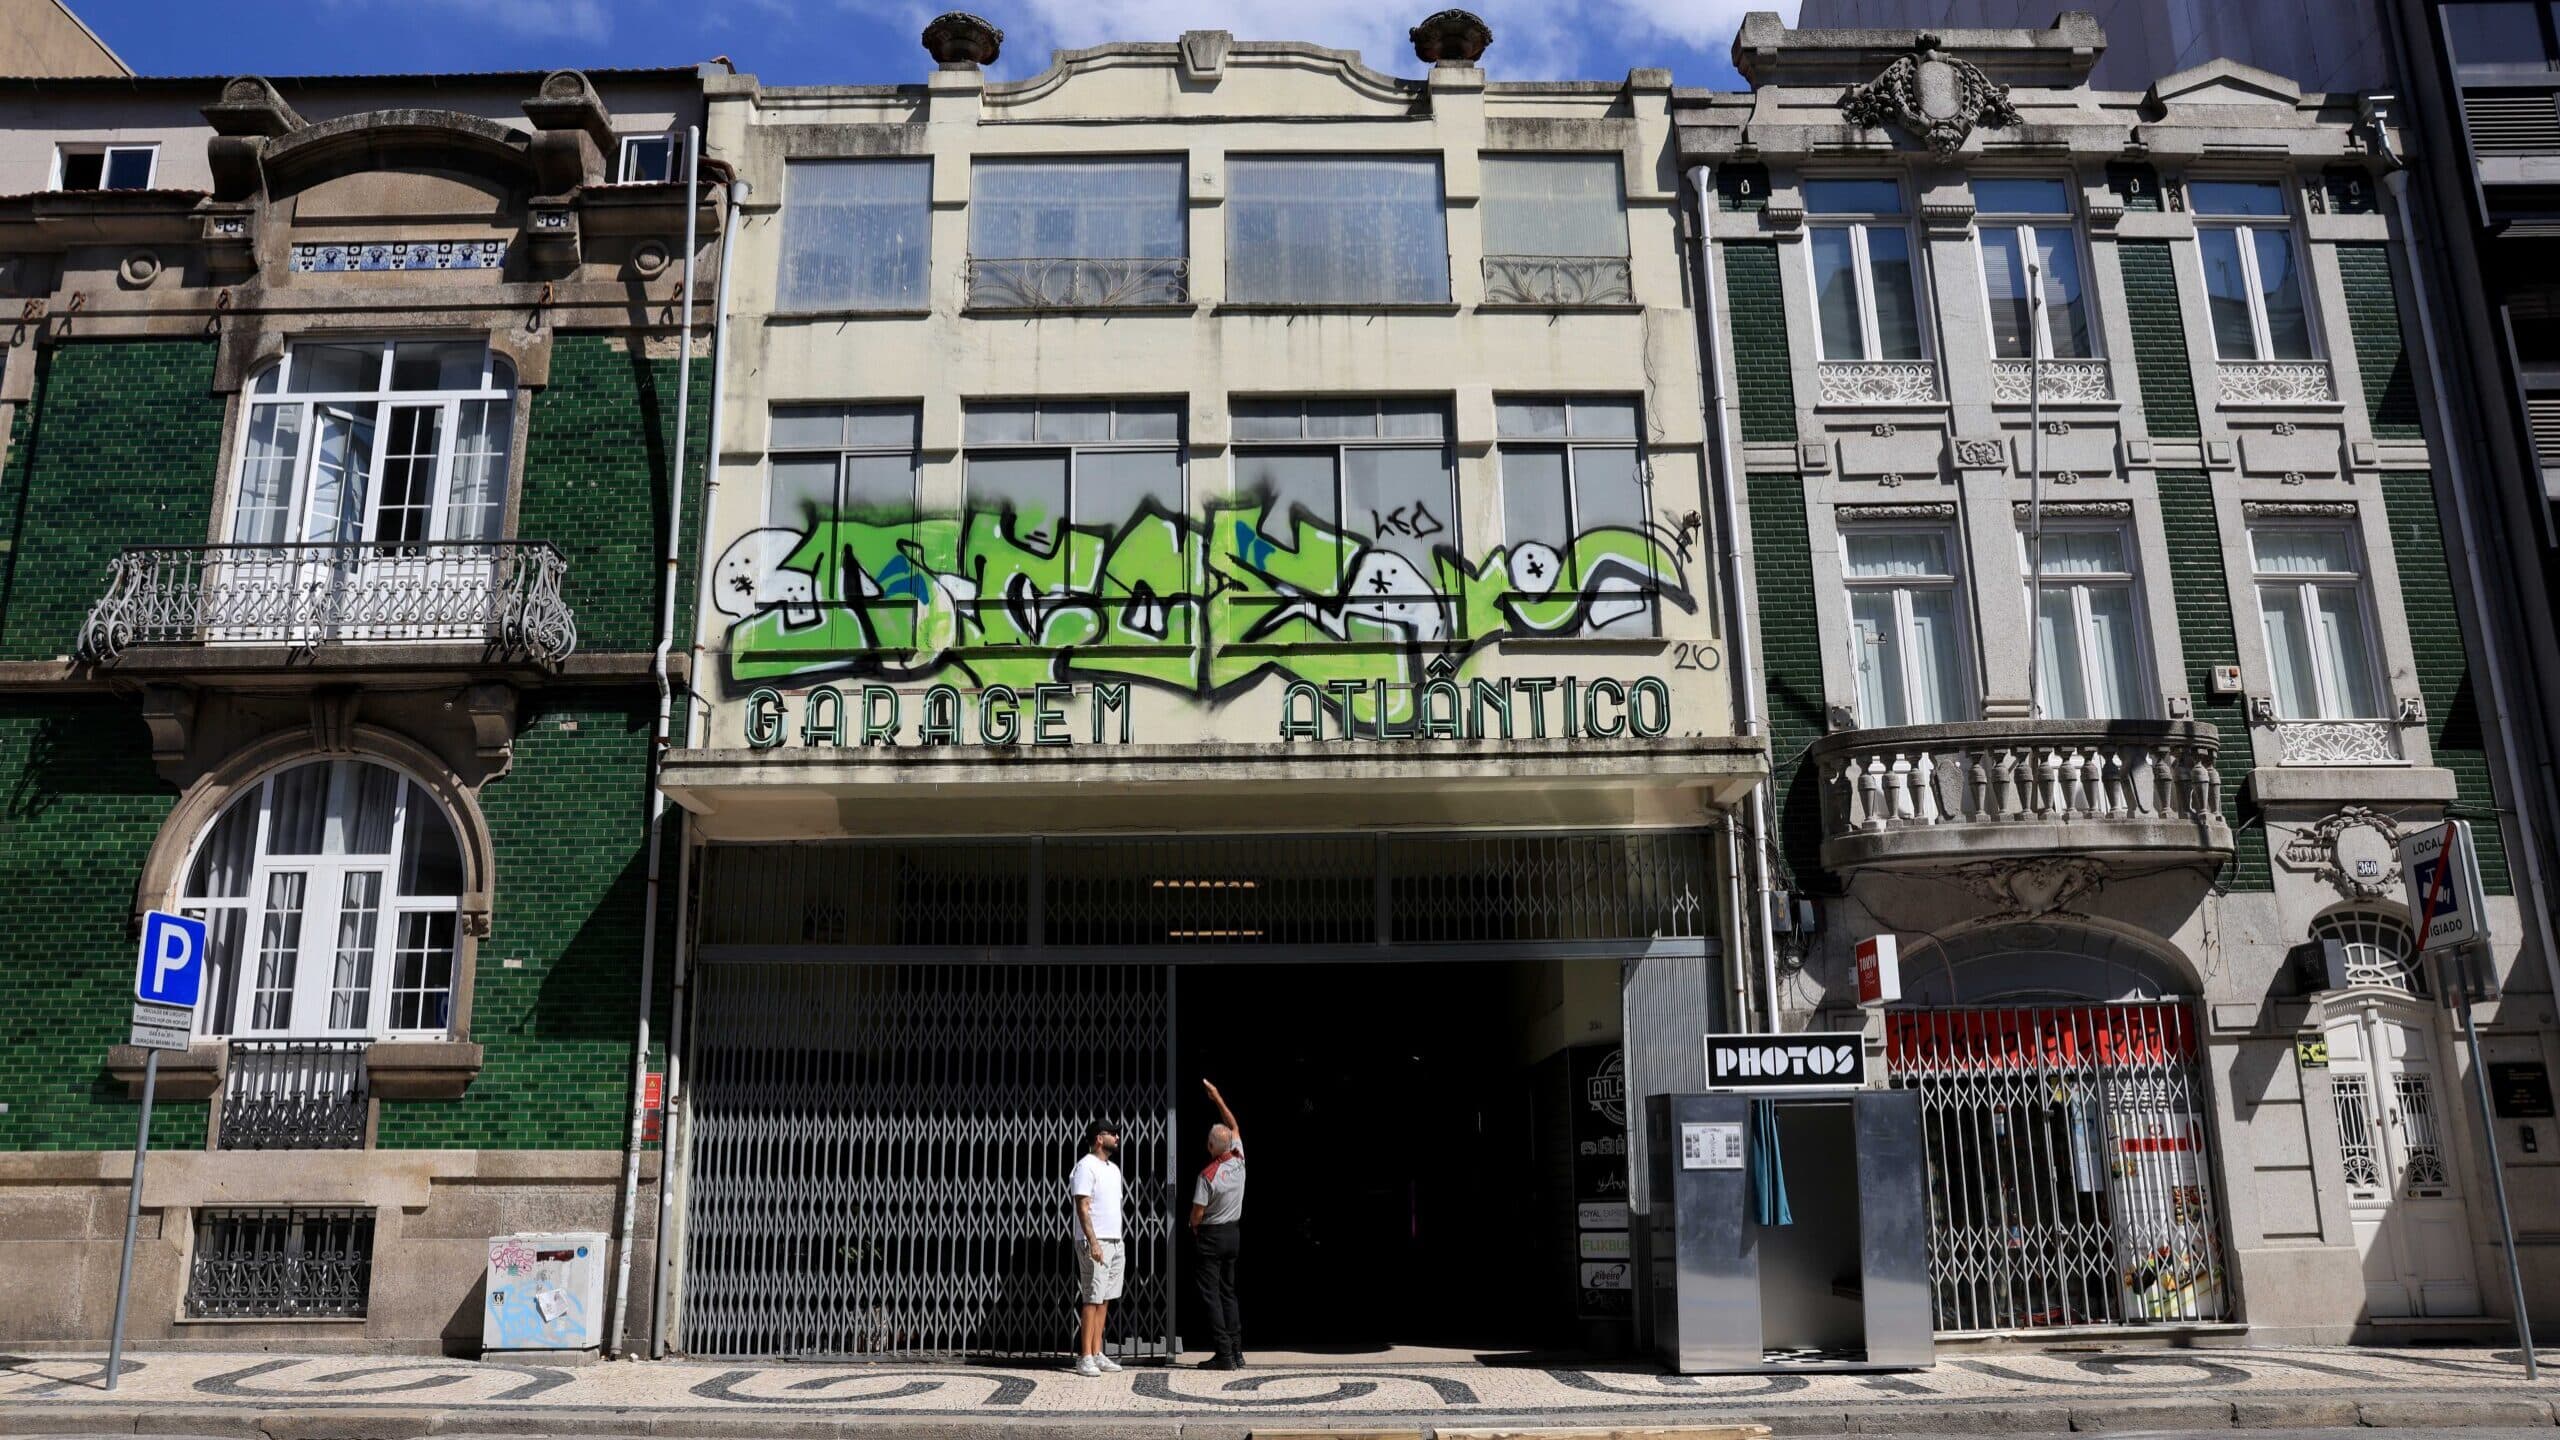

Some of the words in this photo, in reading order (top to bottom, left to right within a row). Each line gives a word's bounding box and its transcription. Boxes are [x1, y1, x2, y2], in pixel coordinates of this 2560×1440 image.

[745, 682, 1134, 748] GARAGEM
[1280, 653, 1671, 741] ATLÂNTICO
[2412, 837, 2445, 855] LOCAL
[2358, 861, 2377, 874] 360
[2425, 919, 2463, 939] IGIADO
[153, 922, 192, 993] P
[1715, 1045, 1855, 1077] PHOTOS
